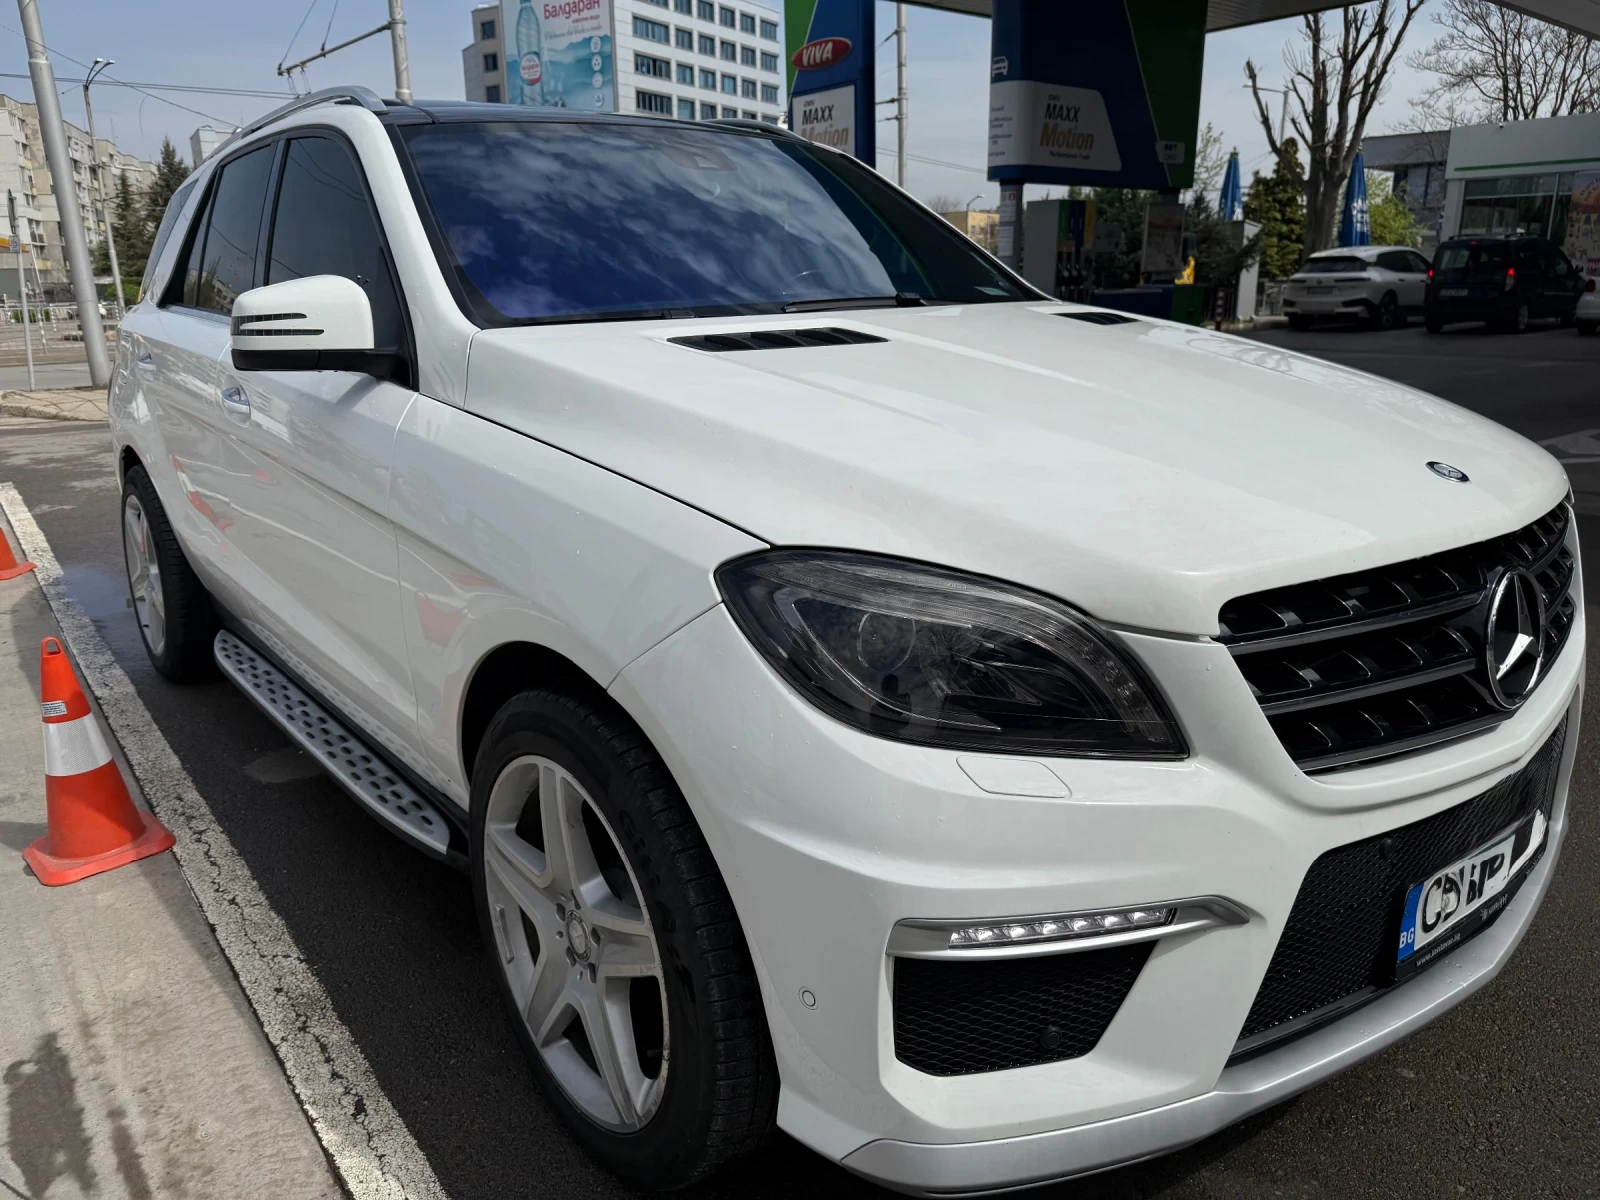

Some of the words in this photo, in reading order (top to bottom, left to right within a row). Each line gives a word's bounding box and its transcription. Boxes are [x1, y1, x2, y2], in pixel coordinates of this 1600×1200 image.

[543, 0, 601, 20] Балдаран
[802, 41, 833, 67] VIVA
[802, 104, 834, 126] MAXX
[1044, 103, 1080, 122] MAXX
[1040, 122, 1094, 150] Motion
[1399, 926, 1415, 949] BG
